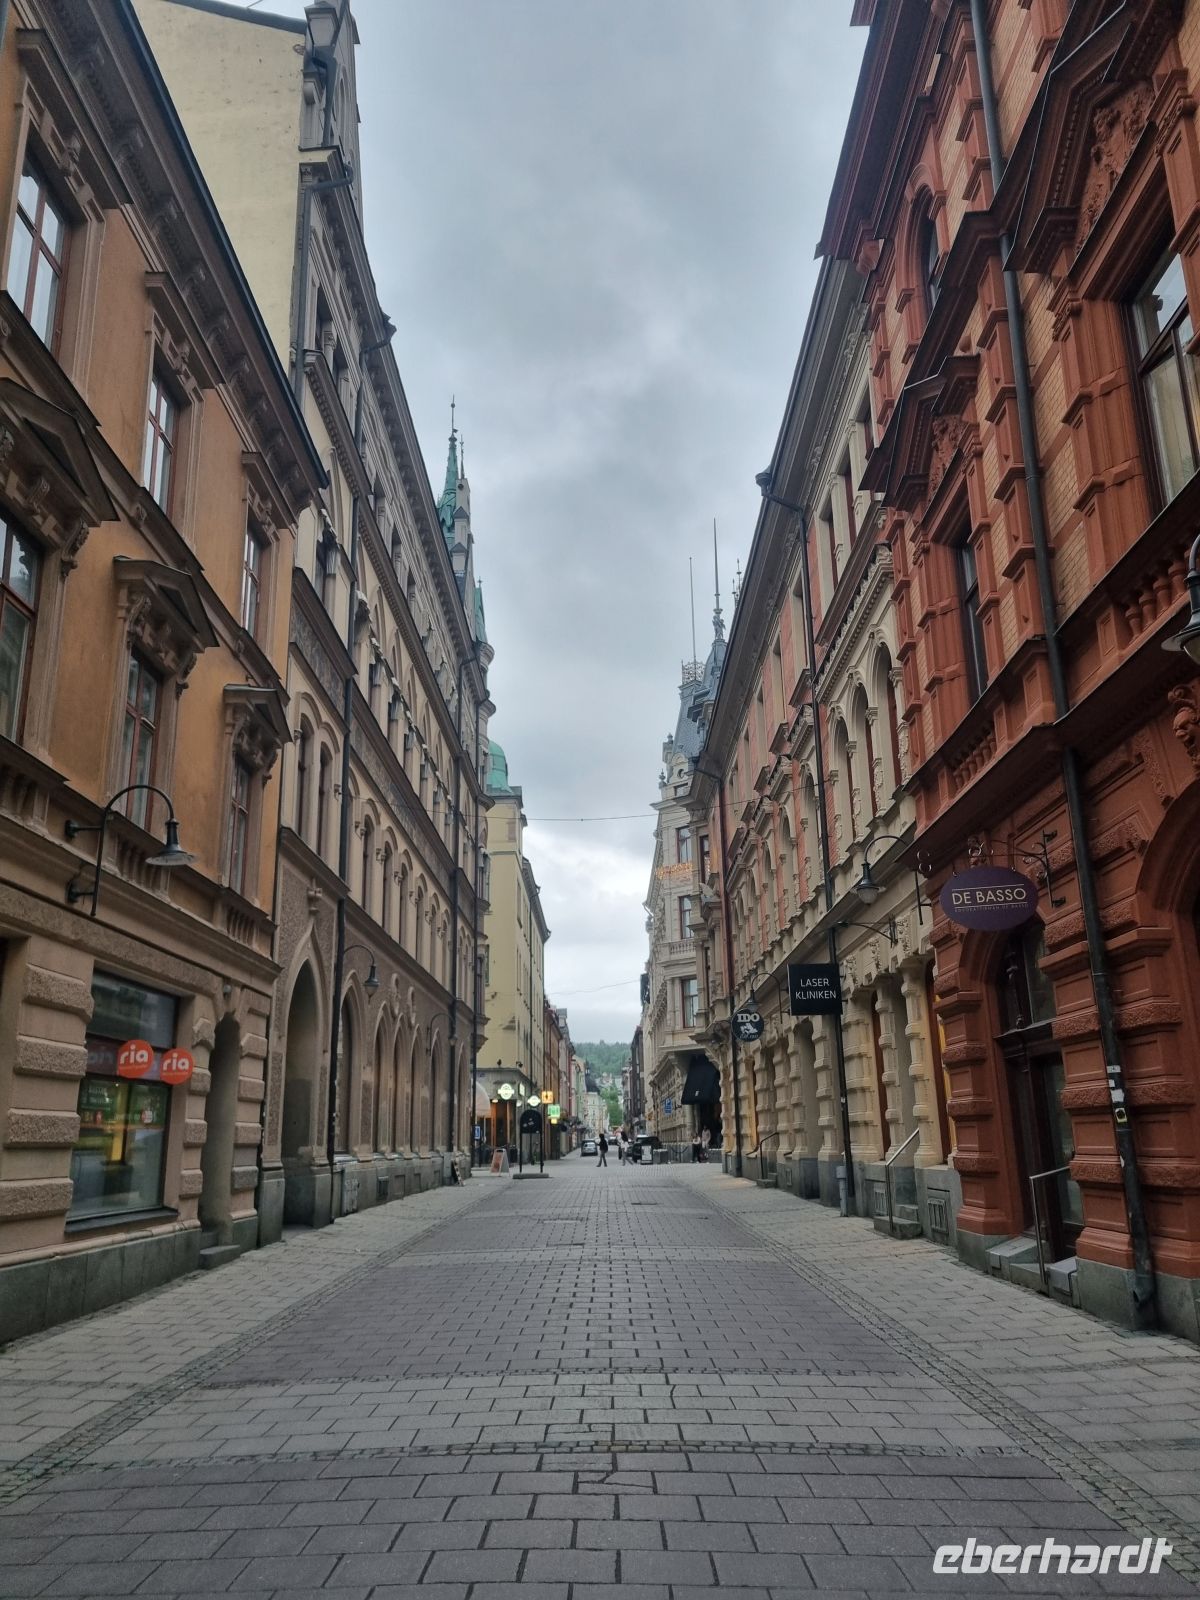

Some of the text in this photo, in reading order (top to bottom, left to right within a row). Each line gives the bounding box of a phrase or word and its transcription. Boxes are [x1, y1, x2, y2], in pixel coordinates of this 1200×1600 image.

[952, 888, 1026, 905] DE BASSO
[800, 978, 830, 987] LASER
[795, 990, 837, 1000] KLINIKEN
[737, 1013, 760, 1023] IDO
[120, 1044, 149, 1064] ria
[162, 1052, 190, 1071] ria
